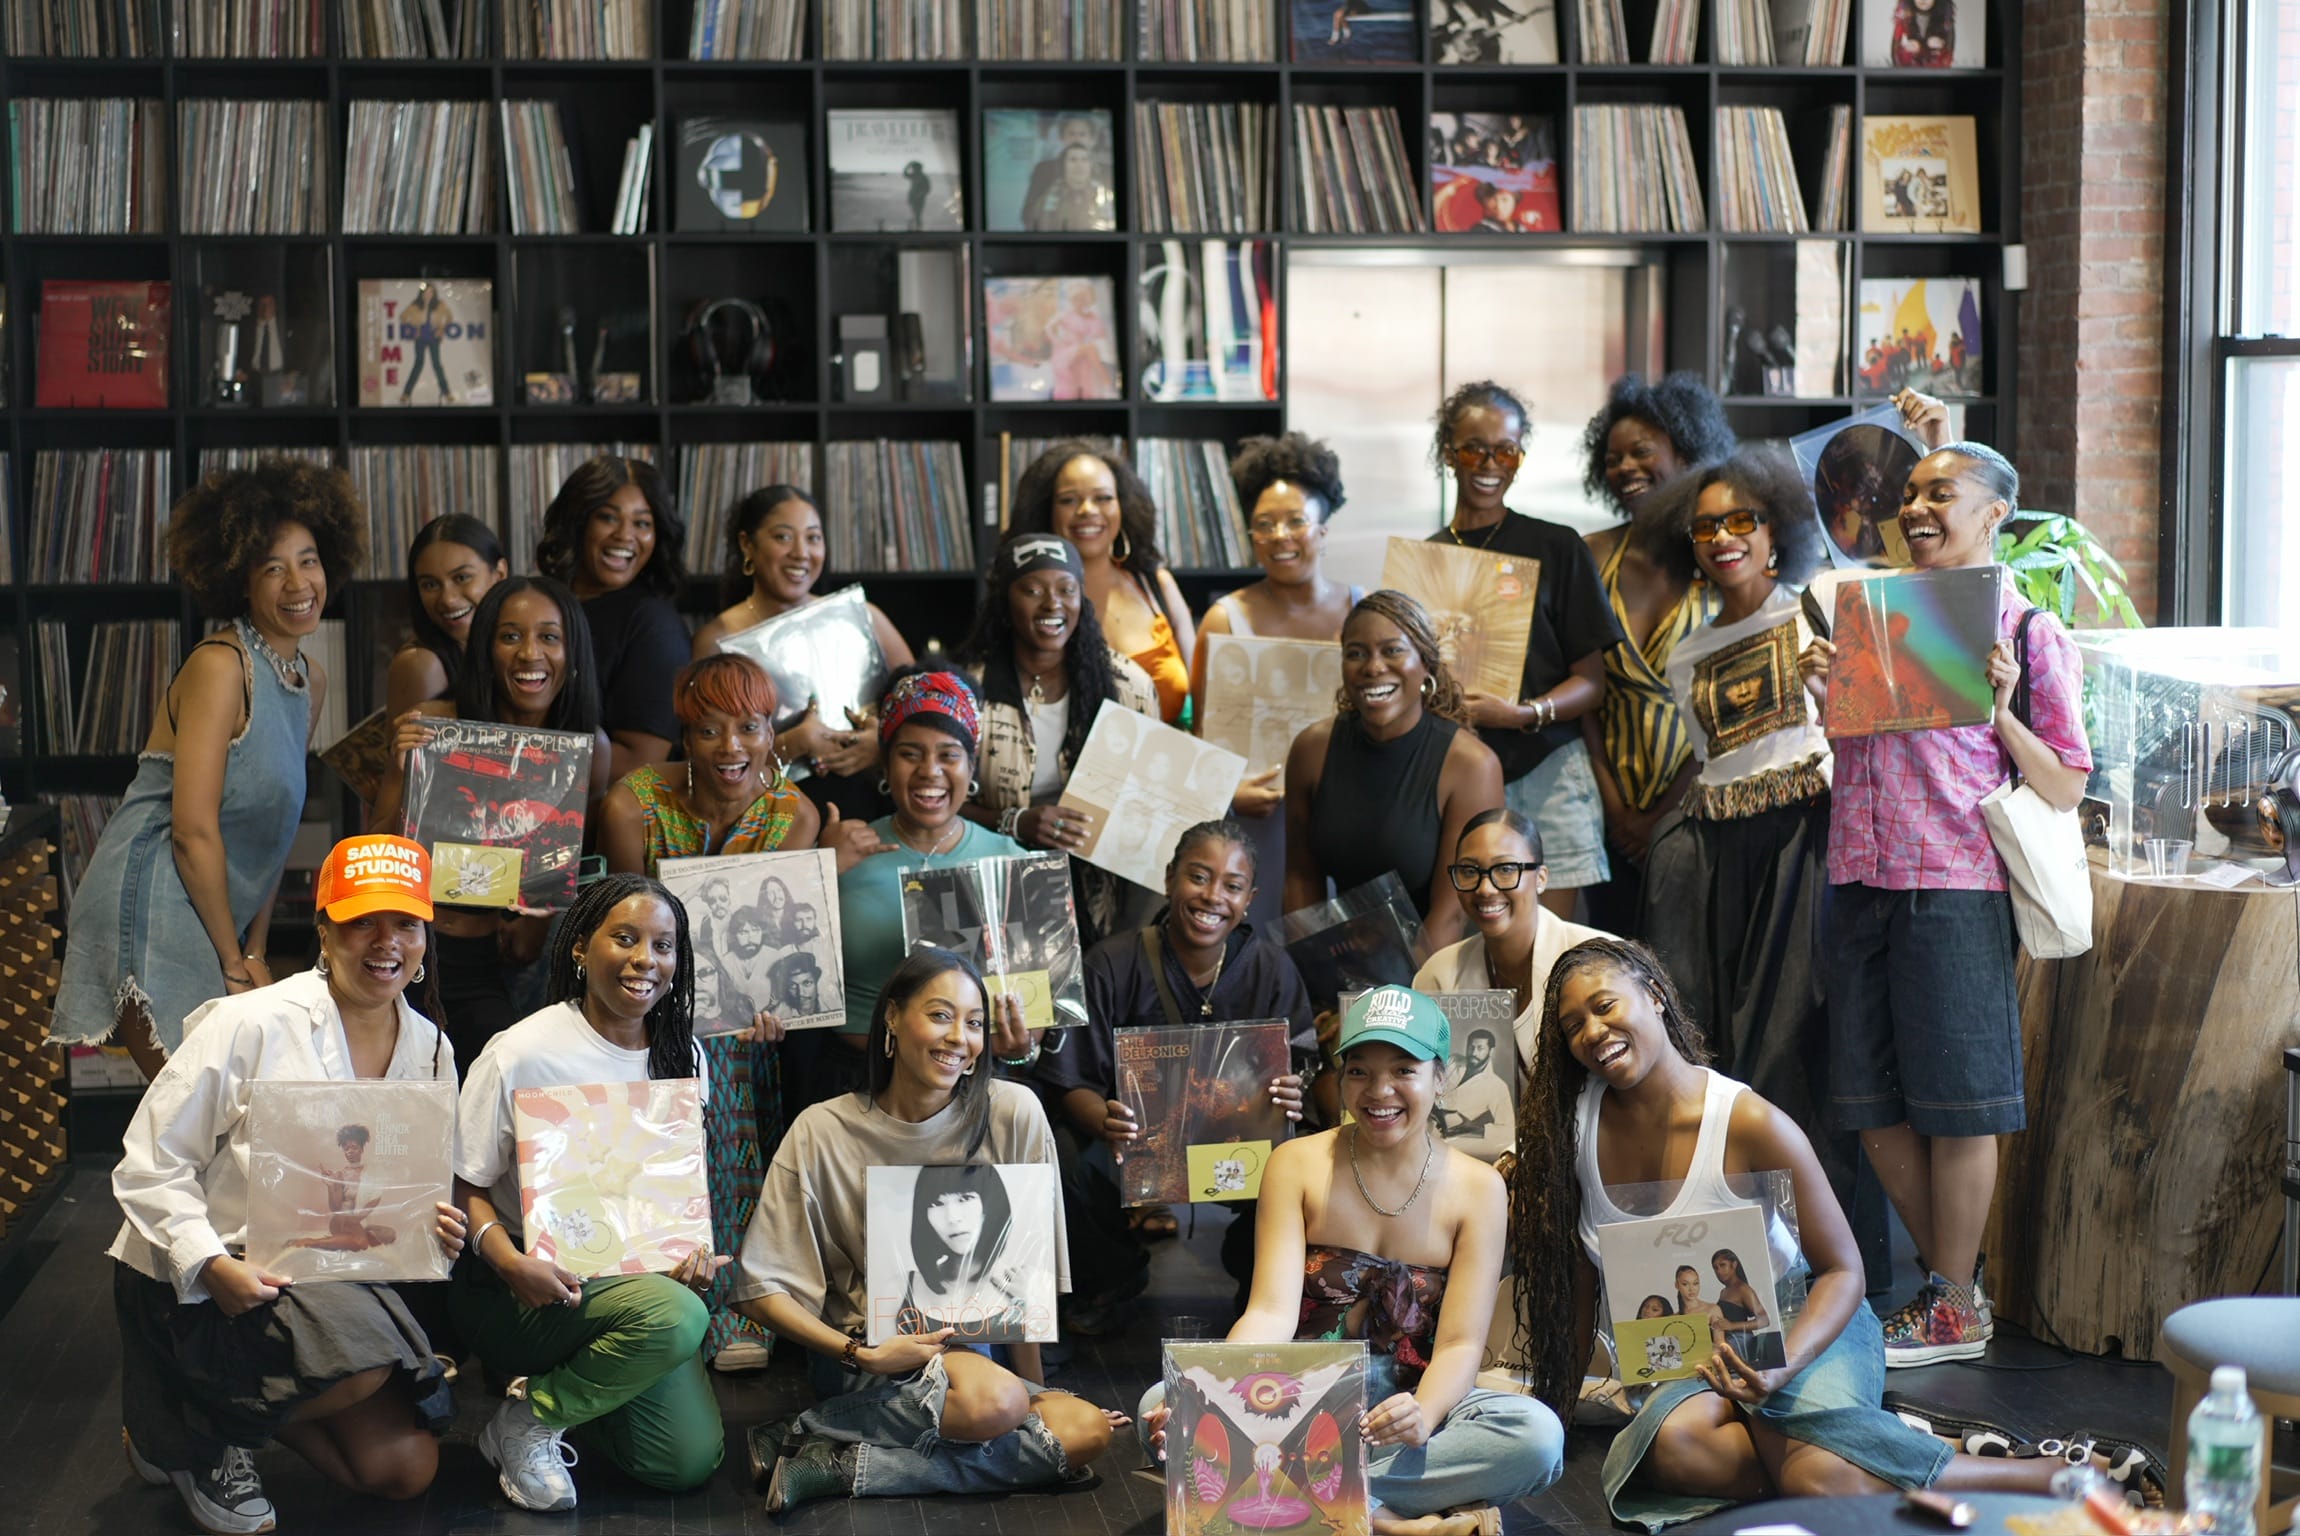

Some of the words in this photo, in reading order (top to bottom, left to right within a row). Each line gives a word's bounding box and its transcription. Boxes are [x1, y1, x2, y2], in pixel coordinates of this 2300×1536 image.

[433, 724, 473, 744] YOU
[477, 728, 507, 748] THE
[511, 732, 567, 753] PEOPLE
[346, 843, 419, 865] SAVANT
[343, 859, 422, 883] STUDIOS
[1367, 989, 1412, 1014] BUILD
[1436, 995, 1513, 1020] ERGRASS
[1365, 1014, 1408, 1027] CREATIVE
[1122, 1044, 1191, 1060] DELFONICS
[517, 1091, 545, 1099] MOON
[375, 1144, 409, 1156] BUTTER
[874, 1295, 1050, 1337] Fantôme
